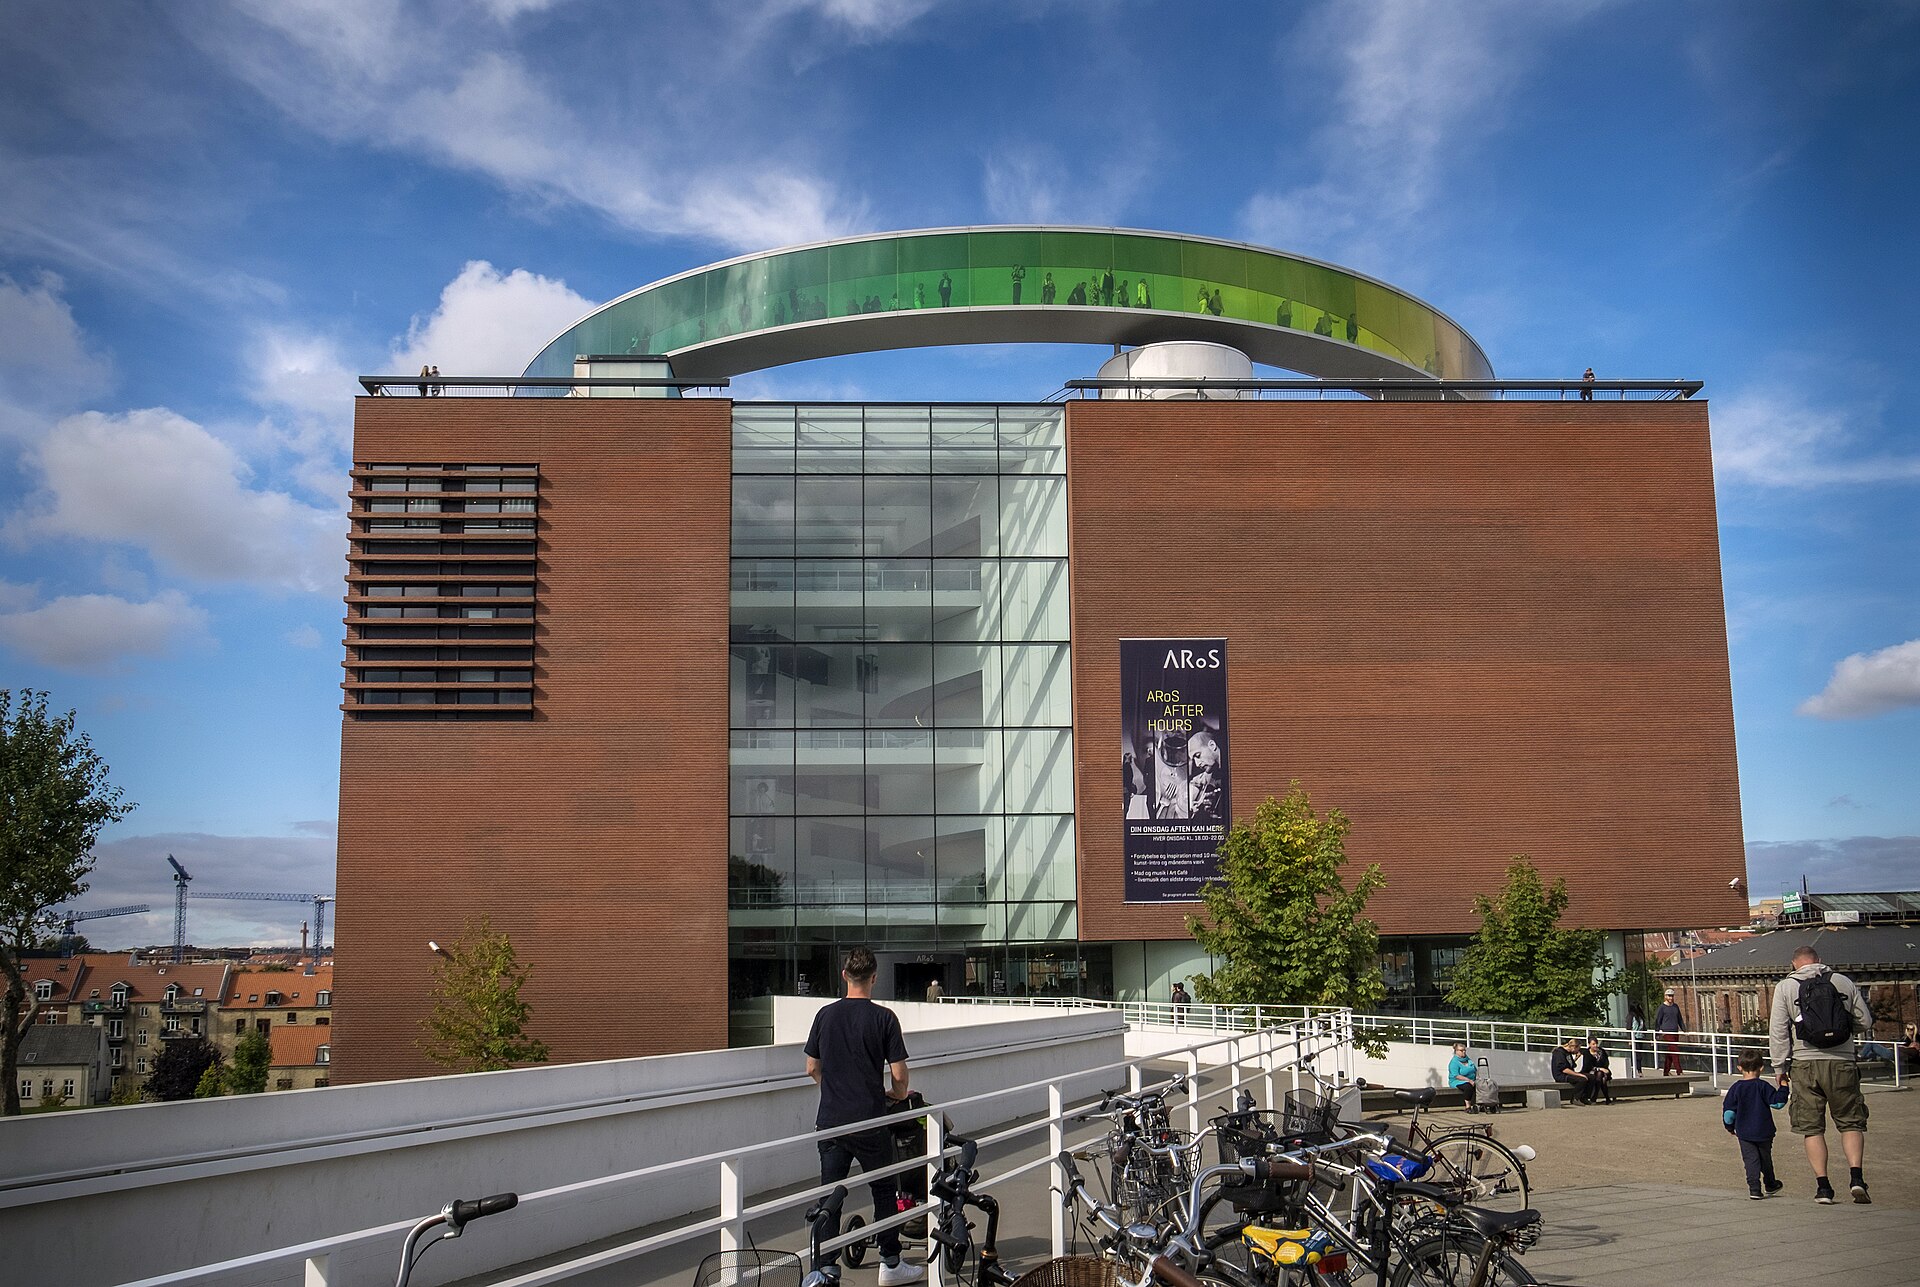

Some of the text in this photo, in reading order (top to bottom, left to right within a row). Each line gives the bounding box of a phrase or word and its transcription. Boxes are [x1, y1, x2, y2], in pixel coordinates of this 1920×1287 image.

[1163, 649, 1220, 669] ARoS
[1146, 690, 1180, 703] ARoS
[1163, 704, 1204, 717] AFTER
[1147, 718, 1192, 732] HOURS
